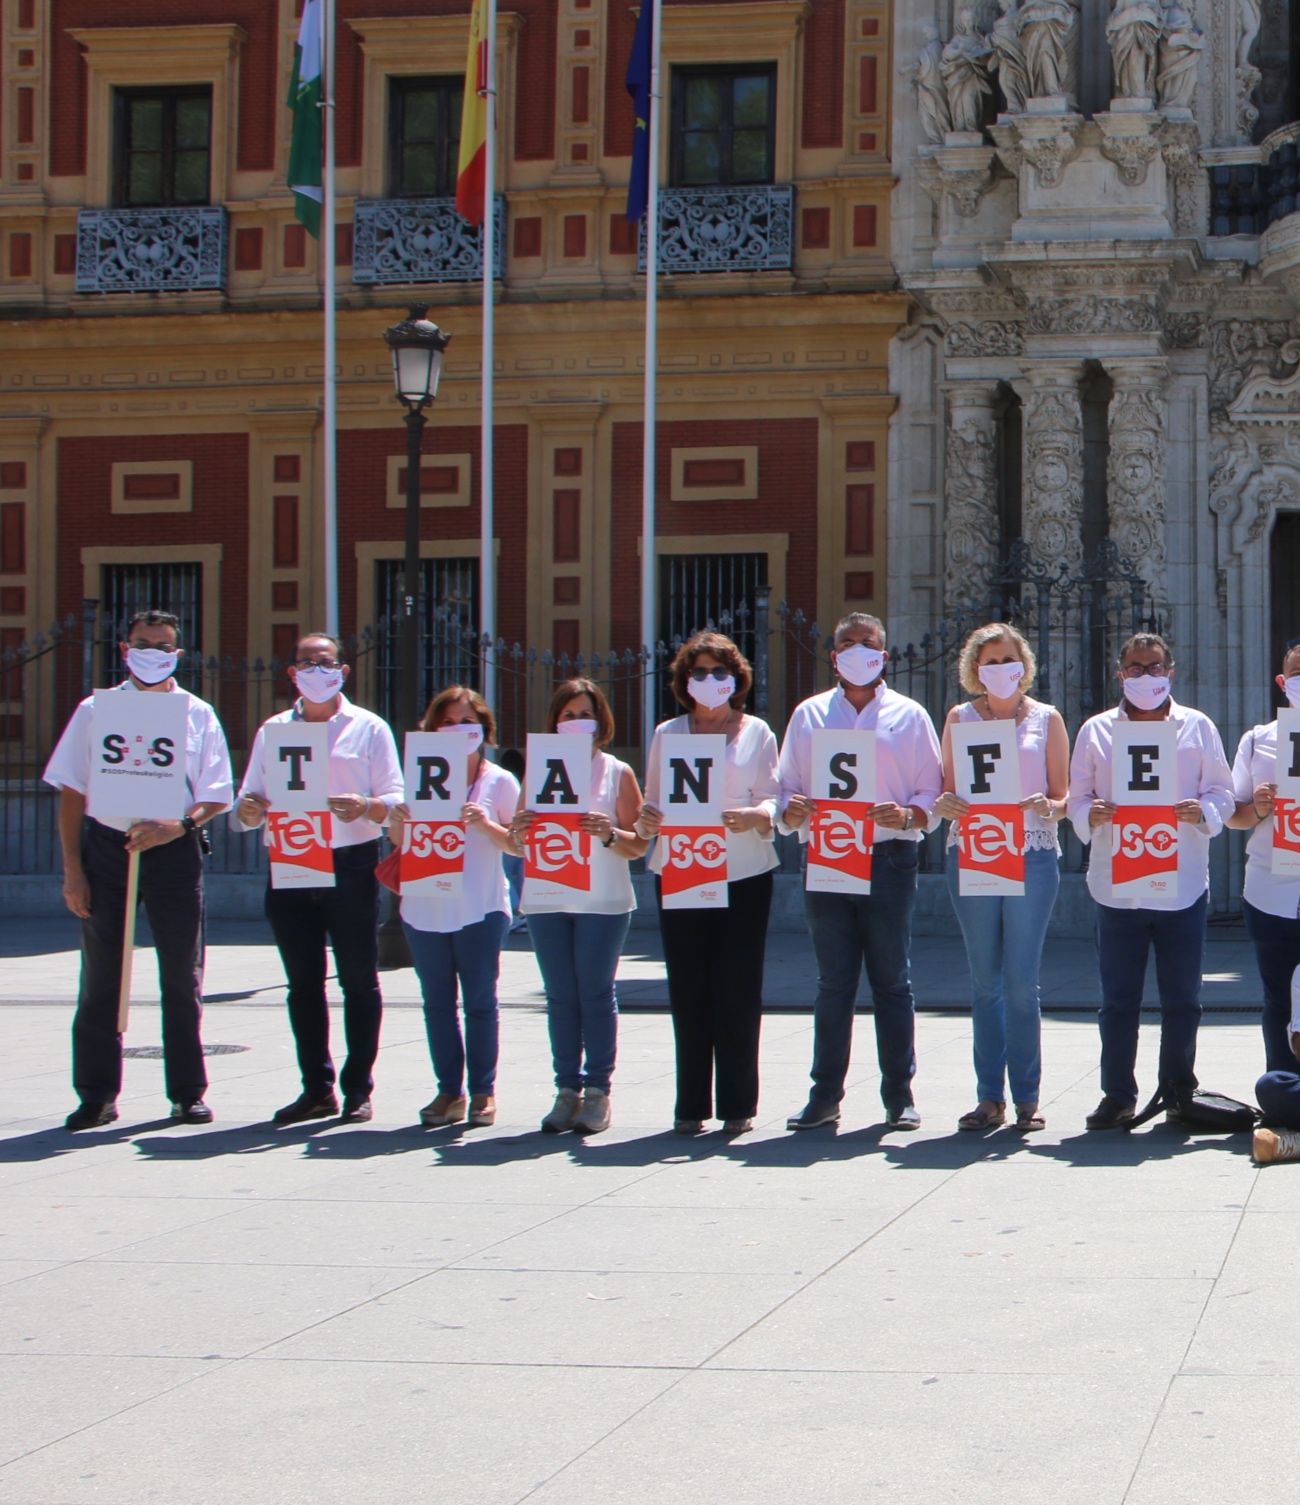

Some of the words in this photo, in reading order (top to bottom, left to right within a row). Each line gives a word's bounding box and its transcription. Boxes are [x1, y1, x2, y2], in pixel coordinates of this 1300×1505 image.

[279, 746, 311, 791] T
[415, 756, 450, 801] R
[536, 759, 578, 805] A
[669, 758, 713, 804] N
[829, 752, 858, 800] S
[967, 743, 1001, 794] F
[1128, 745, 1160, 791] E
